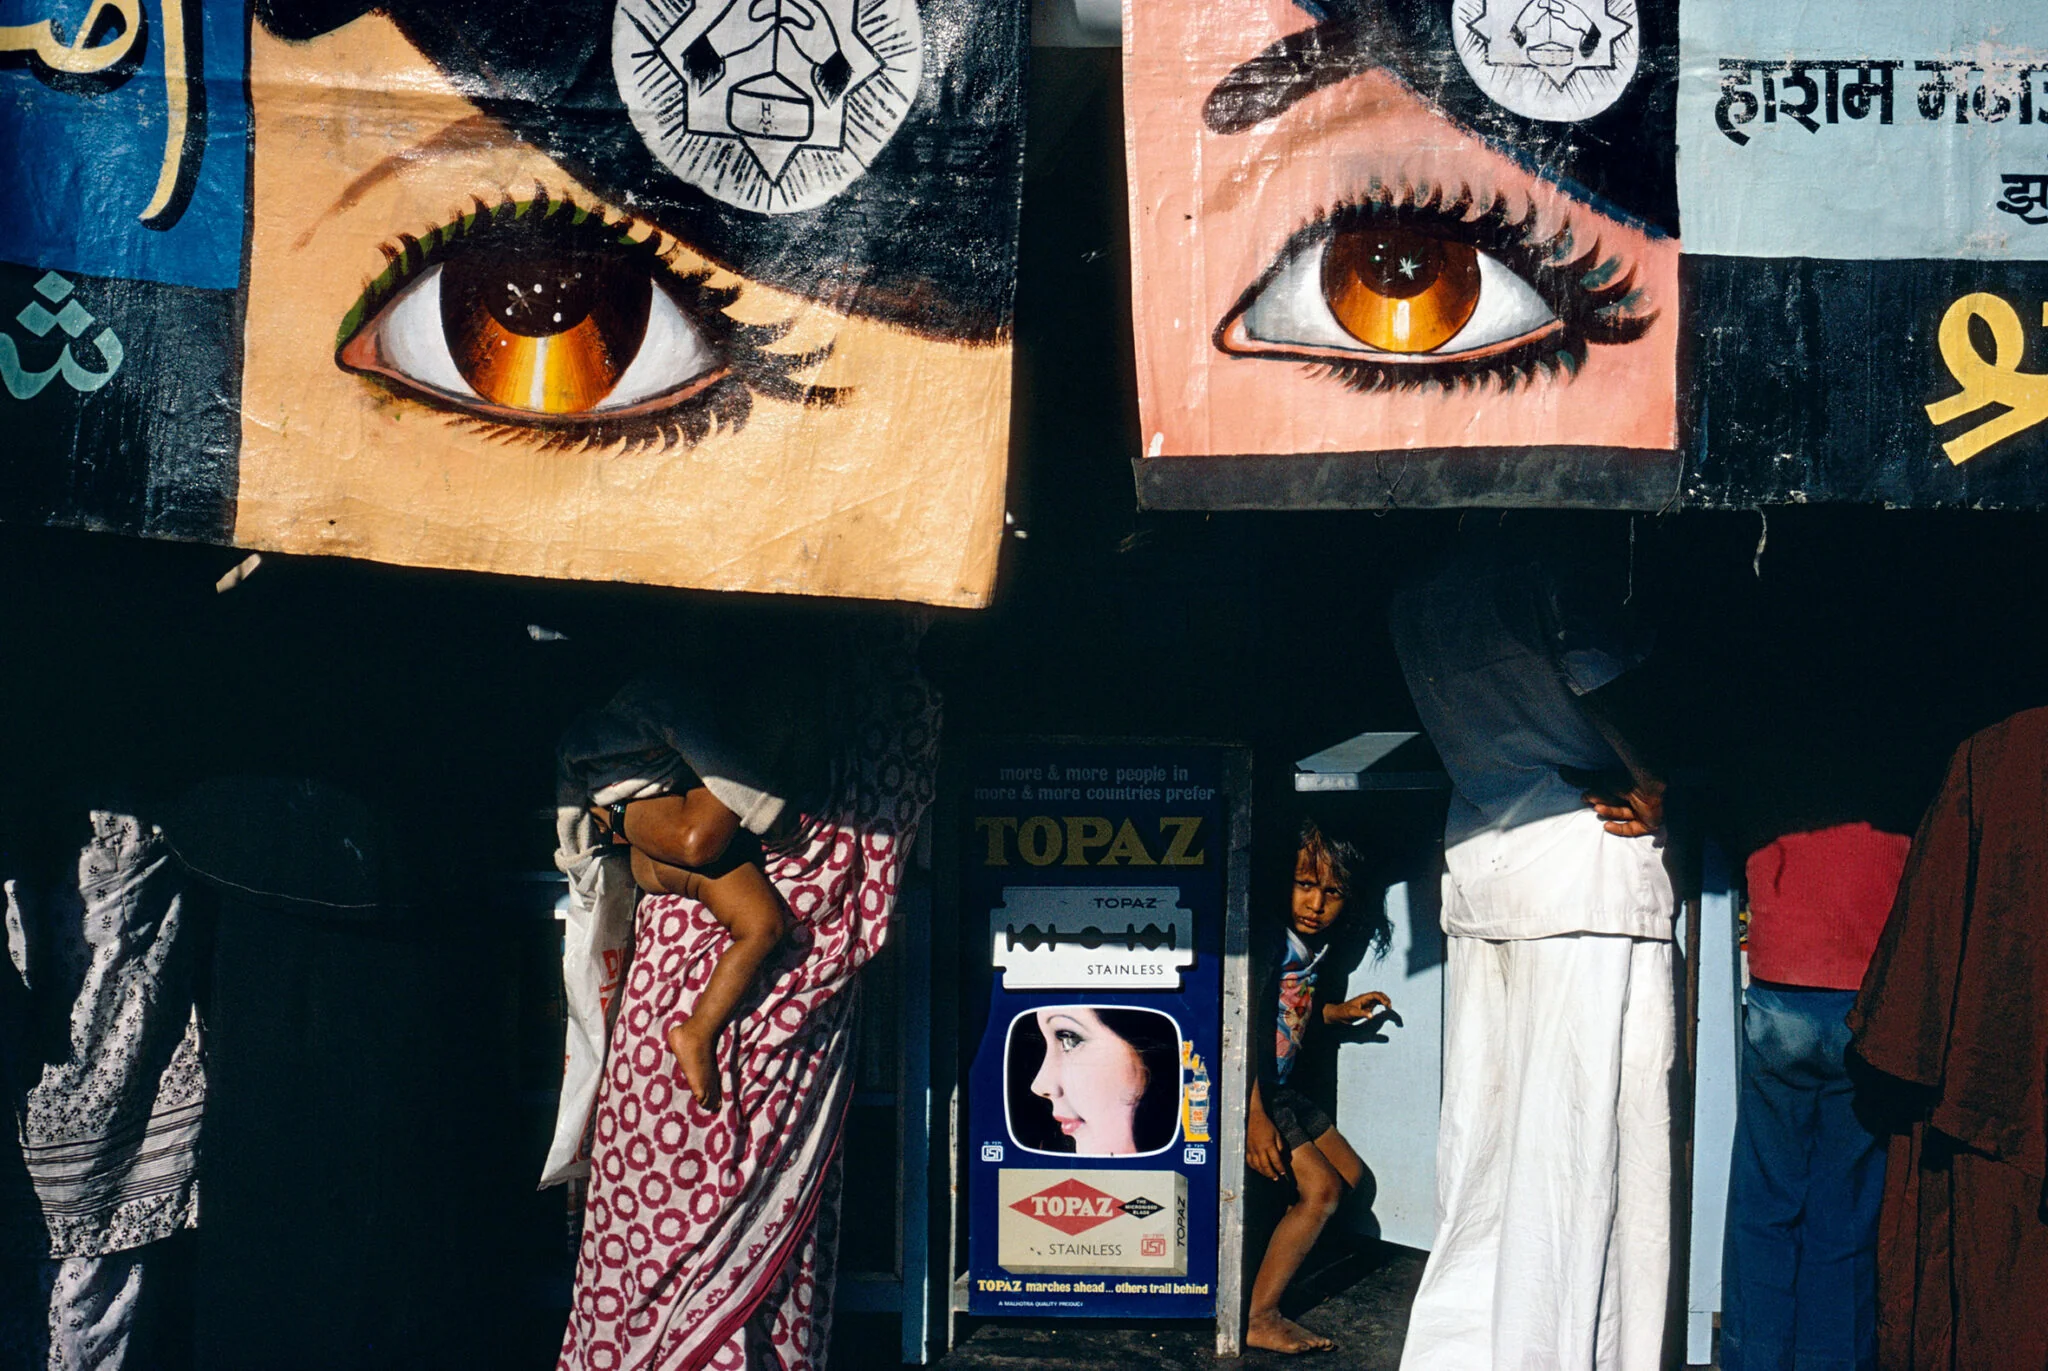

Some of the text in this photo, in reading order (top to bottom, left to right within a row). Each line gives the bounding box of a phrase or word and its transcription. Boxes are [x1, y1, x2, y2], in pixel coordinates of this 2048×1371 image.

[999, 764, 1189, 784] more & more people in
[974, 785, 1216, 803] more & more countries prefer
[974, 816, 1205, 866] TOPAZ
[1093, 898, 1157, 909] TOPAZ
[1087, 964, 1164, 975] STAINLESS
[1031, 1196, 1114, 1217] TOPAZ
[1176, 1196, 1186, 1247] TOPAZ
[1049, 1243, 1122, 1256] STAINLESS
[977, 1280, 1022, 1292] TOPAZ
[1025, 1281, 1071, 1293] marches
[1115, 1282, 1147, 1293] others
[1149, 1283, 1172, 1294] trail
[1173, 1283, 1208, 1294] behind
